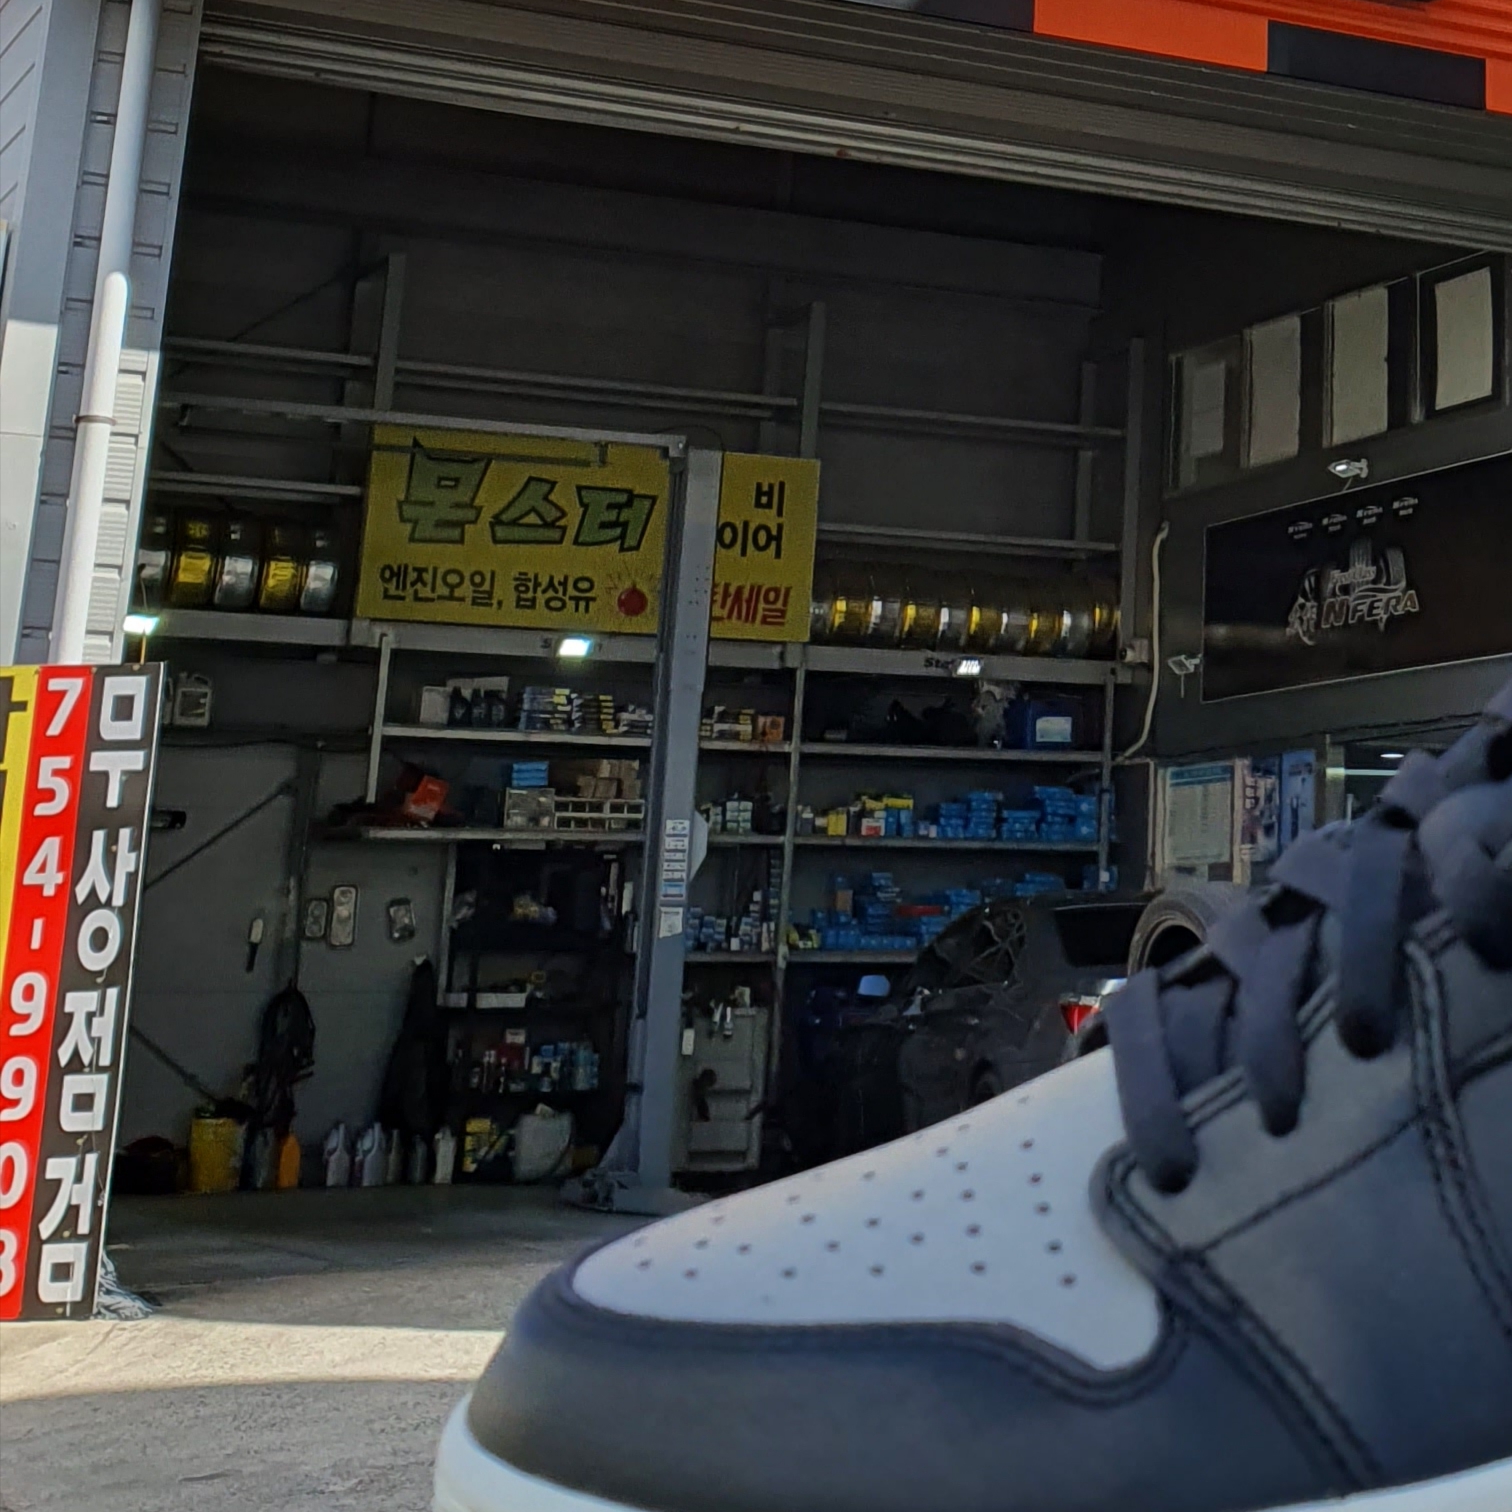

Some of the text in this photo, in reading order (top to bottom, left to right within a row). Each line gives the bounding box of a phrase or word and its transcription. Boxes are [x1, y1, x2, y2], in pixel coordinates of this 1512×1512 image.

[399, 437, 657, 553] 몬스터
[379, 562, 598, 615] 엔진오일, 합성유
[38, 675, 148, 1317] 무상점검
